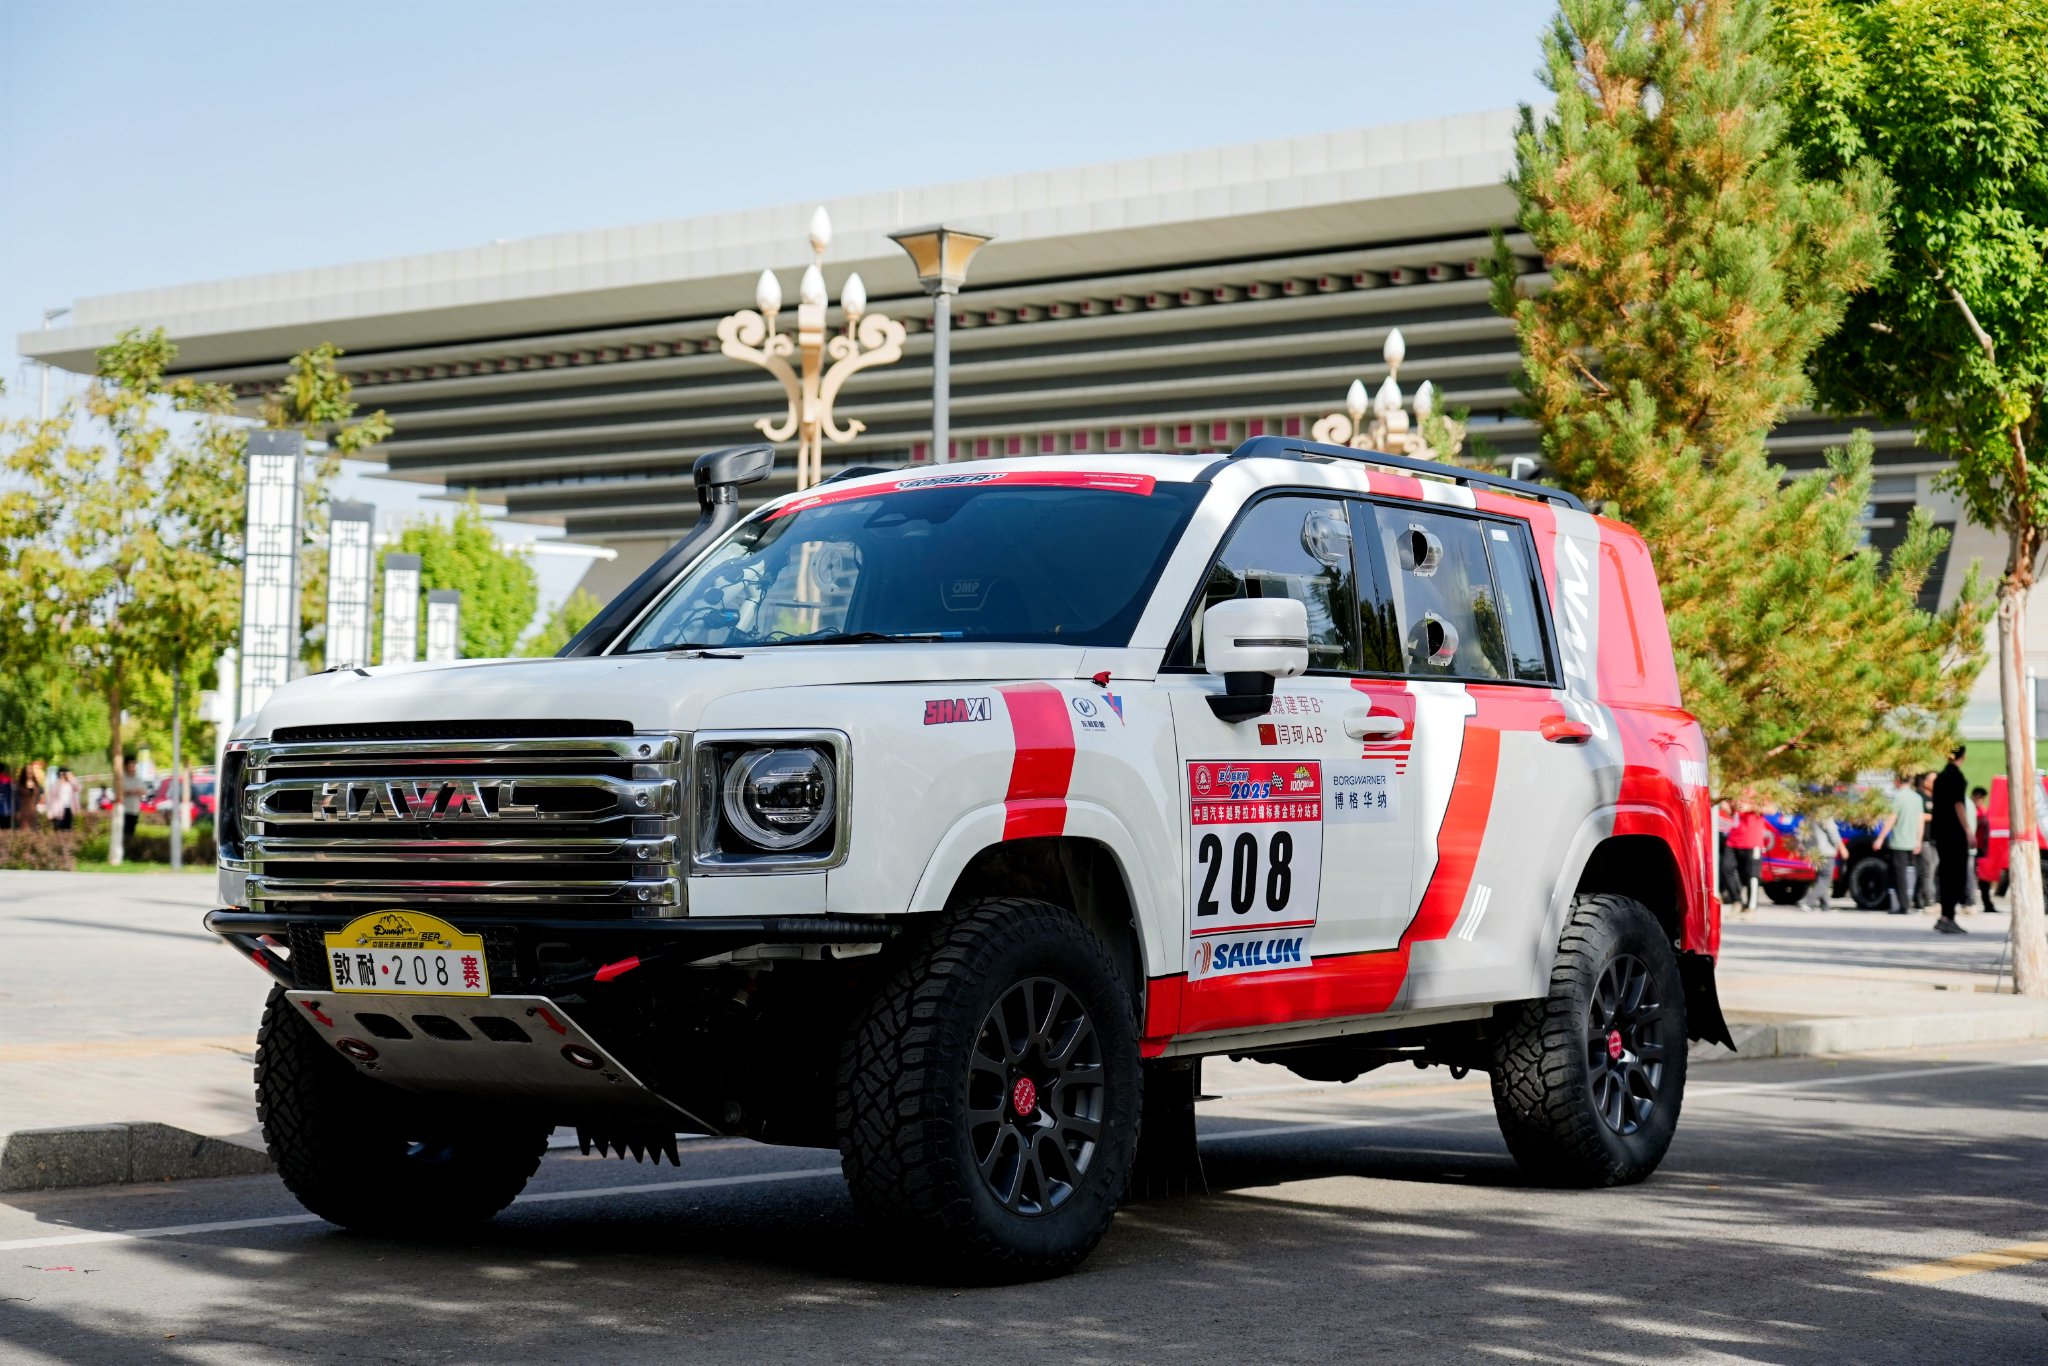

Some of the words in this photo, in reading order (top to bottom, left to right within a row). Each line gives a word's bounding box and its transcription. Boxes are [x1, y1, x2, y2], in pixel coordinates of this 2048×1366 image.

[952, 582, 980, 593] OMP
[1230, 782, 1271, 799] 2025
[1333, 775, 1387, 785] BORGWARNER
[313, 780, 540, 821] HAVAL
[1334, 790, 1387, 809] 博格华纳
[1197, 830, 1293, 917] 208
[1212, 937, 1303, 970] SAILUN
[391, 955, 449, 986] 208
